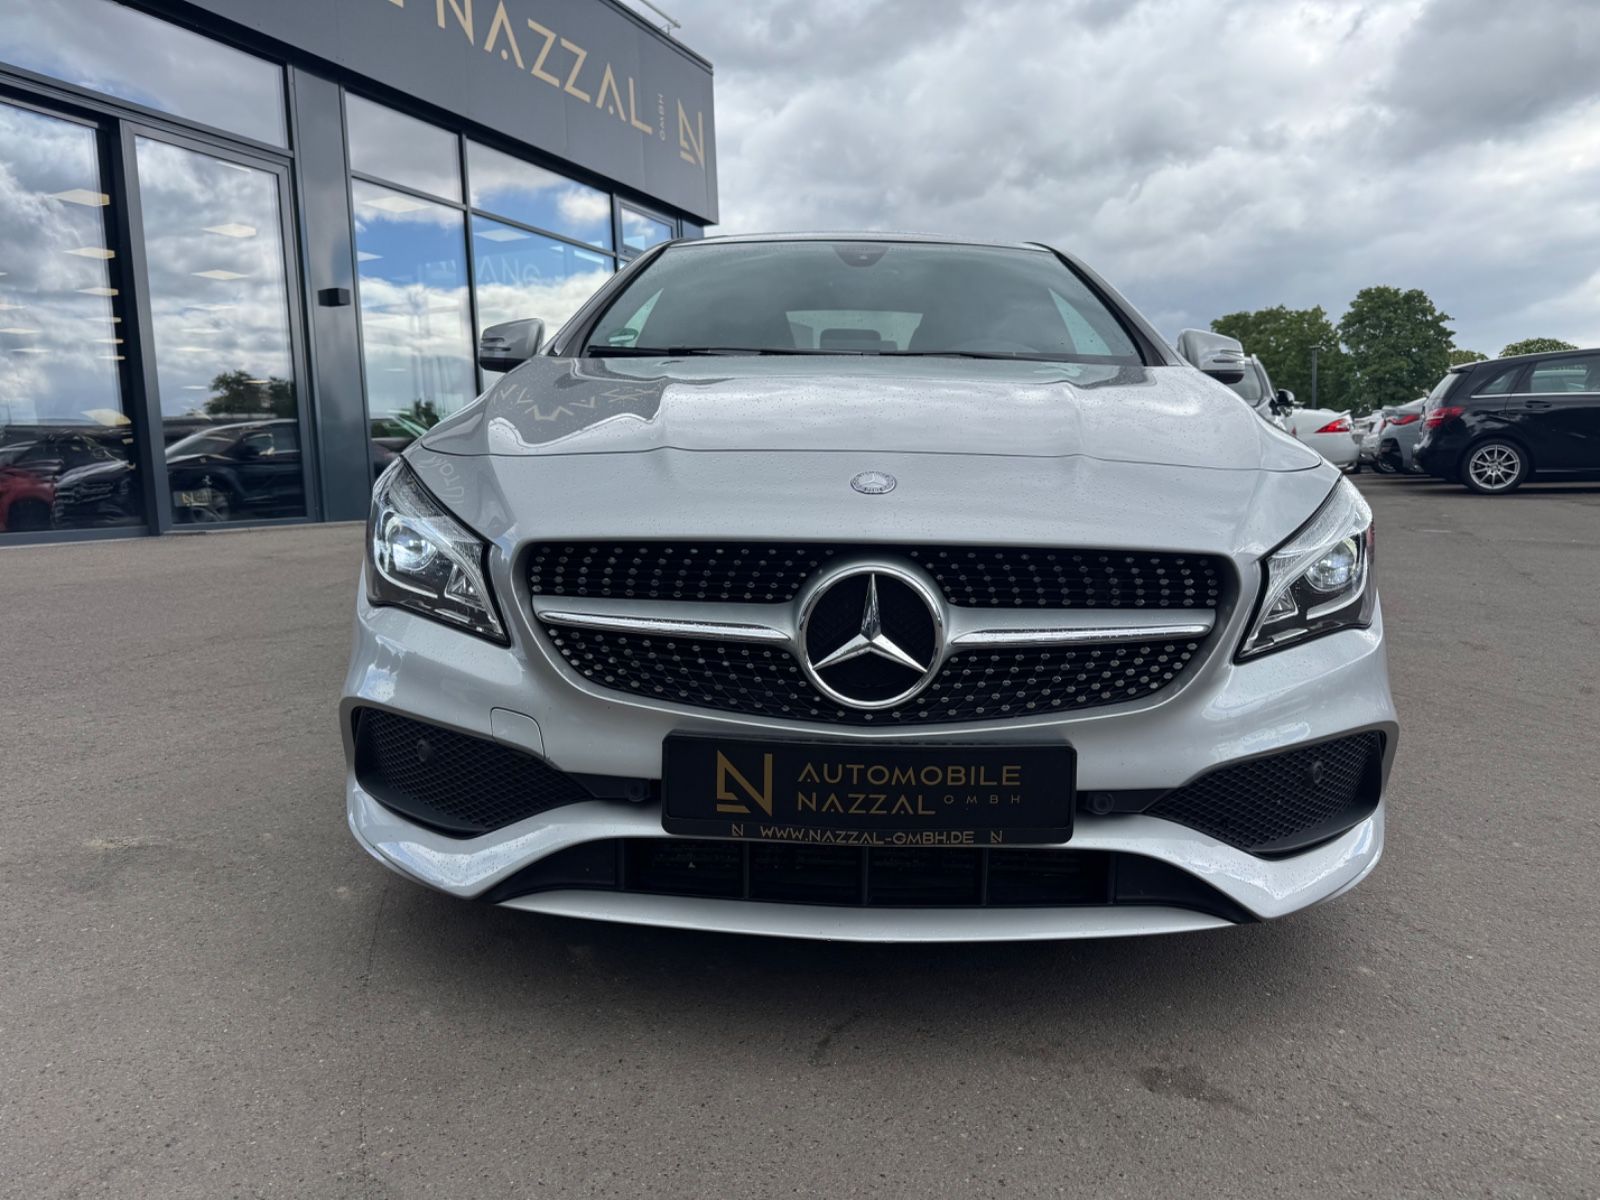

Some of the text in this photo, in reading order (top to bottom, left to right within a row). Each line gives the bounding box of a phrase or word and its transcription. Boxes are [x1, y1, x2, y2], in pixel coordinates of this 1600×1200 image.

[435, 0, 653, 135] NAZZAL
[797, 762, 1022, 787] AUTOMOBILE
[797, 792, 936, 816] NAZZAL
[760, 825, 974, 845] WWW.NAZZAL-GMBH.DE
